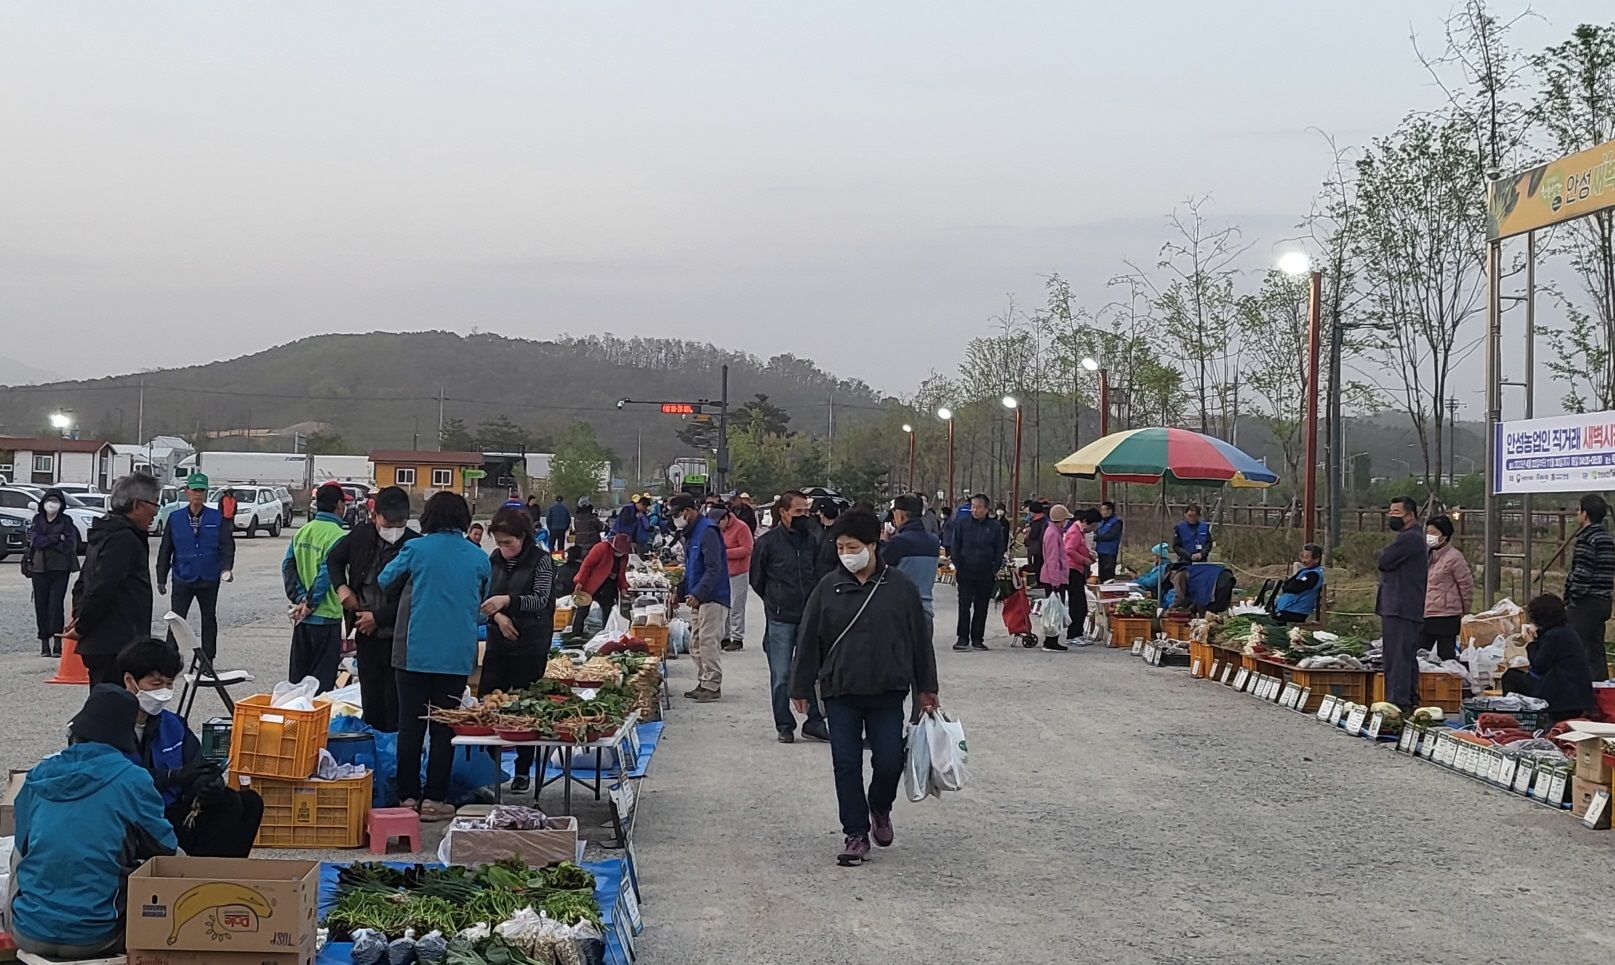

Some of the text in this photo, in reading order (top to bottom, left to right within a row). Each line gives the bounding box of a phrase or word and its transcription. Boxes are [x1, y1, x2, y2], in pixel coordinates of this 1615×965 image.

[1566, 169, 1592, 204] 안성
[1506, 430, 1551, 455] 안성농업인
[1552, 427, 1582, 452] 직거래
[224, 916, 250, 928] Dole
